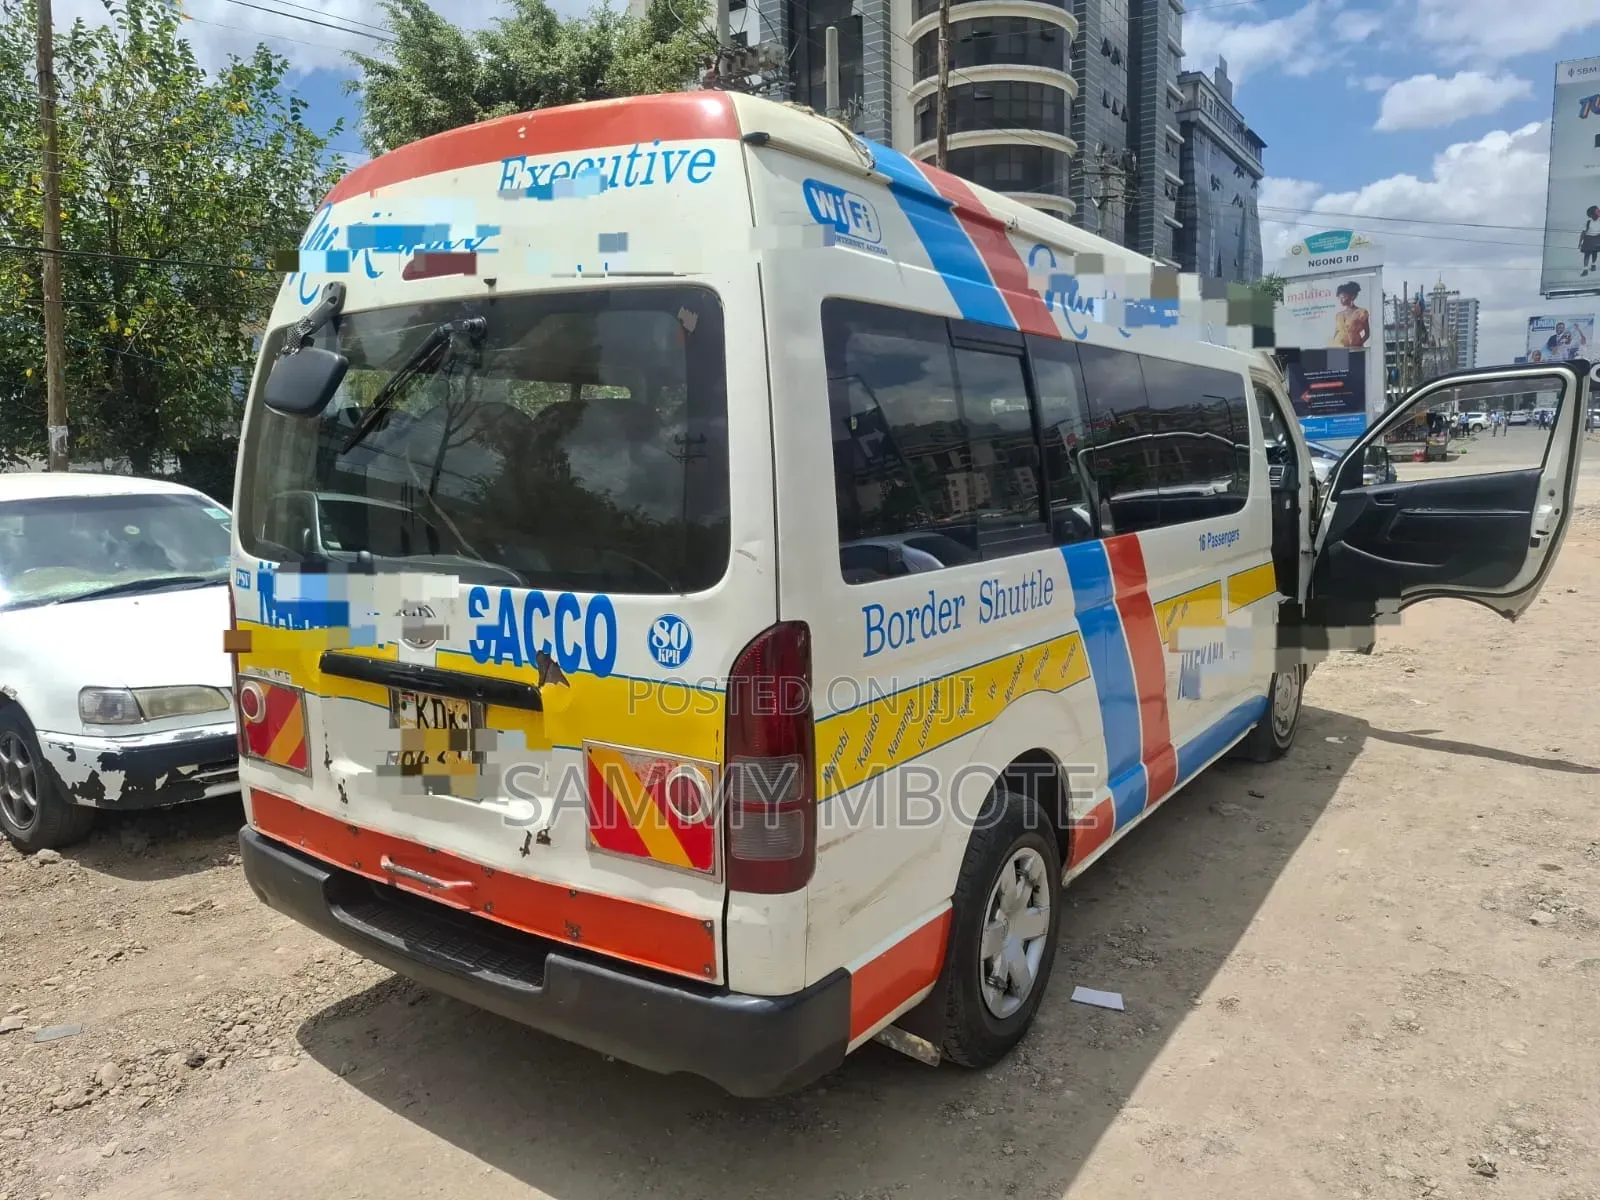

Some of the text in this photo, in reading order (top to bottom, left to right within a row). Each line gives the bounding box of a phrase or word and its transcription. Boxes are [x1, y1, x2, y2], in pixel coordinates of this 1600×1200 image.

[1308, 254, 1359, 268] NGONG RD
[1199, 528, 1240, 552] 16 Passengers
[468, 586, 617, 678] SACCO
[652, 619, 689, 650] 80
[861, 568, 1055, 658] Border Shuttle
[658, 648, 681, 664] KPH
[823, 727, 850, 785] Nairobi
[856, 712, 881, 769] Kajiado
[887, 698, 916, 761] Namanga
